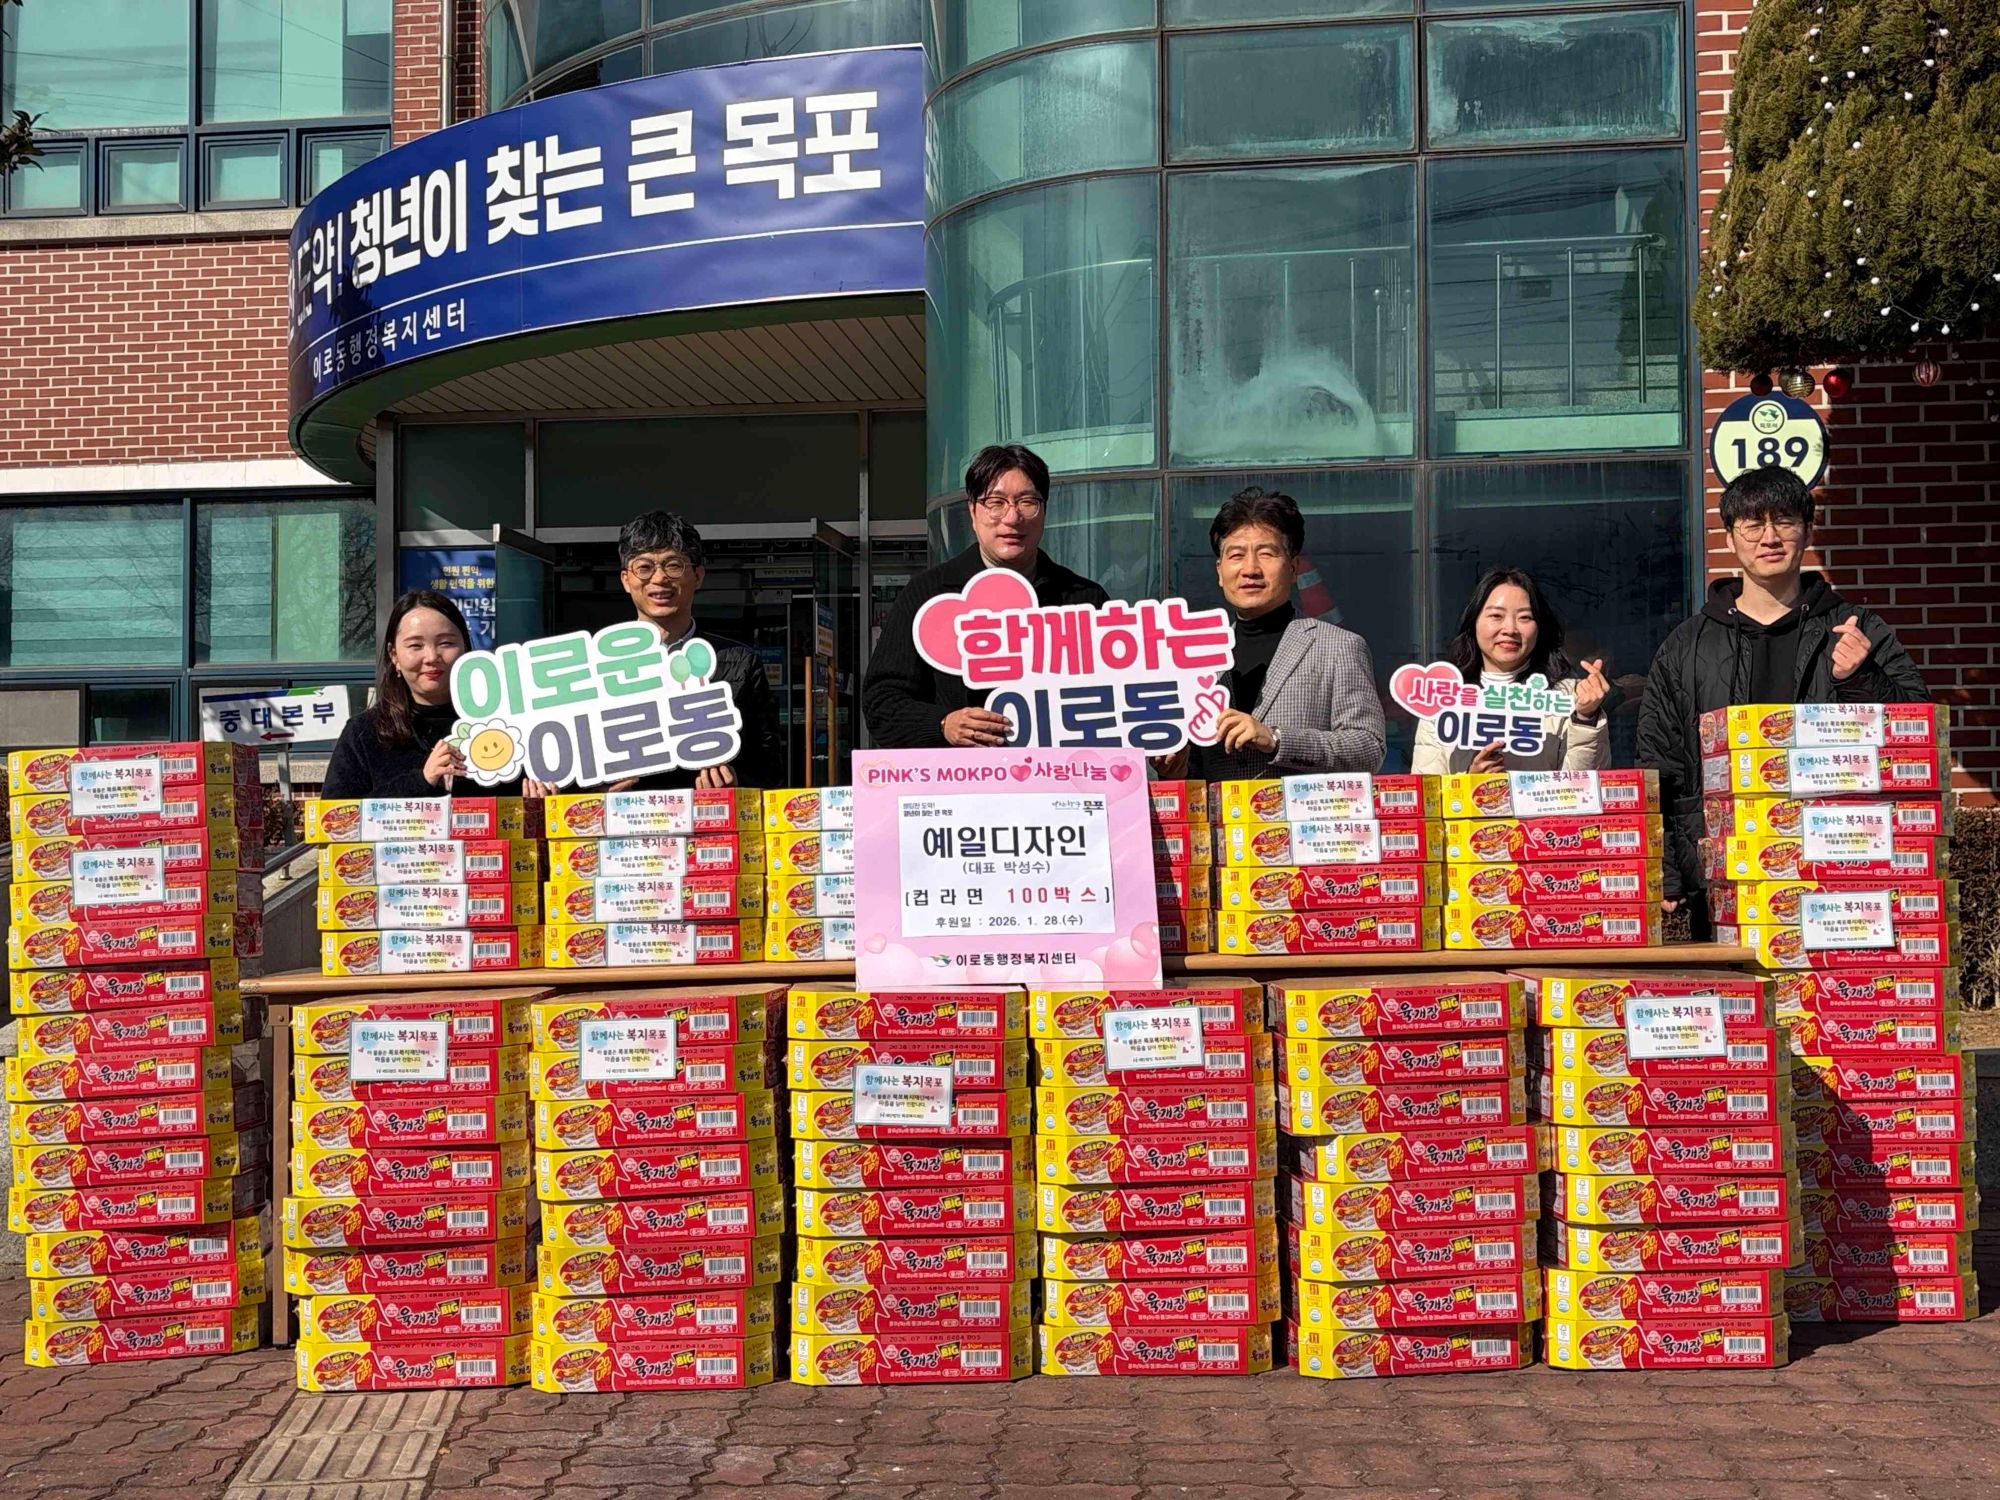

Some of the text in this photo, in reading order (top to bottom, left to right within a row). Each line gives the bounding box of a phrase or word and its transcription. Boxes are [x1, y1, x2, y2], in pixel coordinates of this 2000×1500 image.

[297, 211, 343, 326] 도약!
[350, 159, 467, 290] 청년이
[486, 136, 604, 245] 찾는
[627, 110, 697, 218] 큰
[724, 91, 882, 199] 목포
[313, 298, 465, 383] 이로동행정복지센터
[1731, 437, 1809, 469] 189
[961, 603, 1230, 683] 함께하는
[457, 626, 664, 719] 이로운
[1408, 679, 1572, 713] 사랑을 실천하는
[990, 680, 1185, 751] 이로동
[528, 688, 735, 783] 이로동
[1437, 711, 1543, 753] 이로동
[867, 766, 1008, 783] PINK'S MOKPO
[1034, 762, 1107, 781] 사랑나눔
[922, 826, 1087, 857] 예일디자인
[1543, 828, 1599, 849] 육개장 BIG
[1604, 846, 1636, 855] 72 551
[962, 860, 1051, 875] (대표 박성수)
[1324, 879, 1360, 896] 육개장
[1542, 875, 1580, 893] 육개장
[935, 915, 972, 928] 후원일
[988, 916, 1020, 927] 2026.
[956, 952, 1076, 966] 이로동행정복지센터
[1836, 981, 1874, 999] 육개장
[1398, 998, 1458, 1021] 육개장 BIG
[1636, 1006, 1713, 1018] 함께사는 복지목포
[111, 1022, 147, 1039] 육개장
[1114, 1016, 1192, 1031] 함께사는 복지목포
[1463, 1017, 1477, 1027] 72
[1480, 1016, 1499, 1027] 551
[361, 1029, 438, 1044] 함께사는 복지목포
[590, 1028, 667, 1042] 함께사는 복지목포
[1400, 1050, 1440, 1069] 육개장
[865, 1075, 944, 1088] 함께사는 복지목포
[1857, 1070, 1914, 1091] 육개장 BIG
[1918, 1088, 1952, 1097] 72 551
[1144, 1098, 1204, 1120] 육개장 BIG
[100, 1110, 138, 1128] 육개장
[385, 1110, 445, 1133] 육개장 BIG
[1425, 1145, 1465, 1164] 육개장
[637, 1161, 677, 1180] 육개장
[1677, 1186, 1737, 1208] 육개장 BIG
[644, 1205, 704, 1229] 육개장 BIG
[901, 1201, 941, 1220] 육개장
[1741, 1206, 1775, 1215] 72 551
[709, 1224, 745, 1234] 72 551
[1143, 1242, 1204, 1265] 육개장 BIG
[1412, 1239, 1472, 1263] 육개장 BIG
[1679, 1237, 1719, 1256] 육개장
[384, 1259, 424, 1278] 육개장
[904, 1248, 964, 1270] 육개장 BIG
[1208, 1262, 1244, 1273] 72 551
[968, 1268, 1004, 1278] 72 551
[132, 1280, 190, 1303] 육개장 BIG
[194, 1296, 228, 1306] 72 551
[1145, 1293, 1185, 1312] 육개장
[398, 1303, 458, 1326] 육개장 BIG
[633, 1308, 673, 1327] 육개장
[462, 1322, 498, 1332] 72 551
[1659, 1335, 1701, 1355] 육개장
[898, 1349, 938, 1368] 육개장
